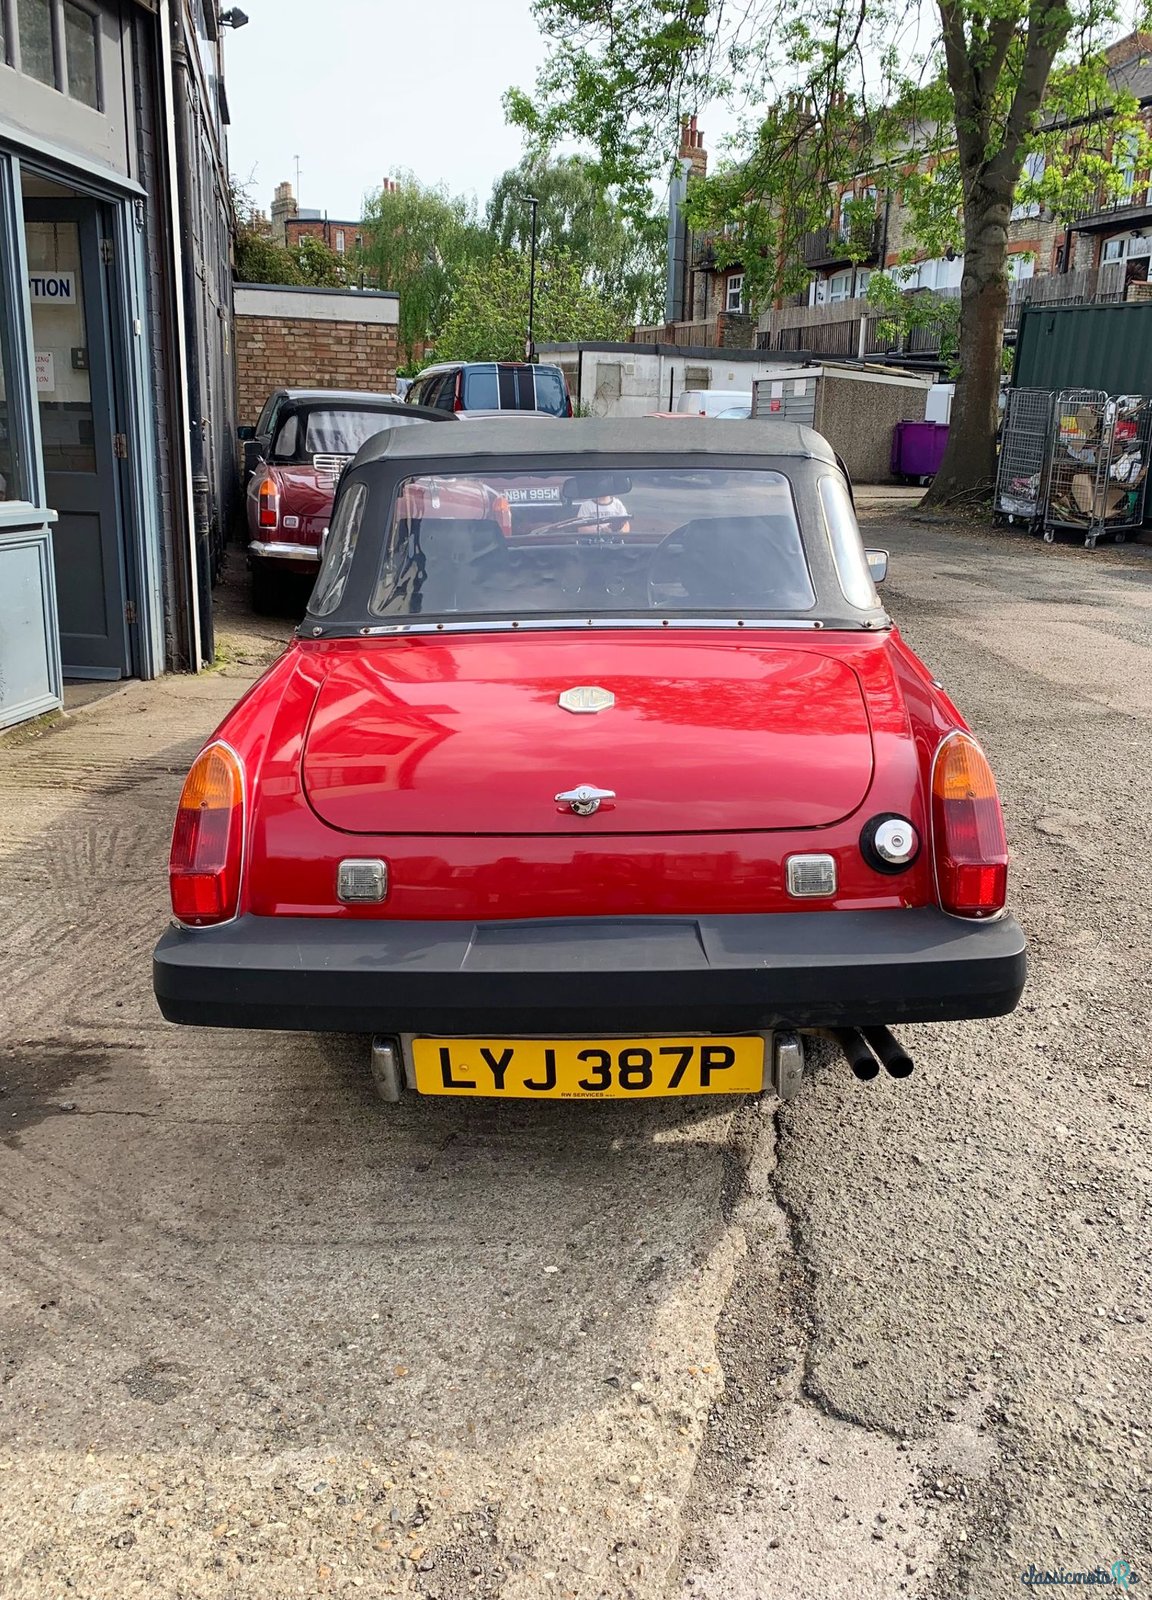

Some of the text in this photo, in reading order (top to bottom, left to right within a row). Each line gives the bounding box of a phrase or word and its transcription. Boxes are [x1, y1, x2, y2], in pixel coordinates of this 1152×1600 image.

[29, 278, 70, 297] TION
[505, 489, 558, 501] NBW 995M
[439, 1045, 736, 1091] LYJ 387P
